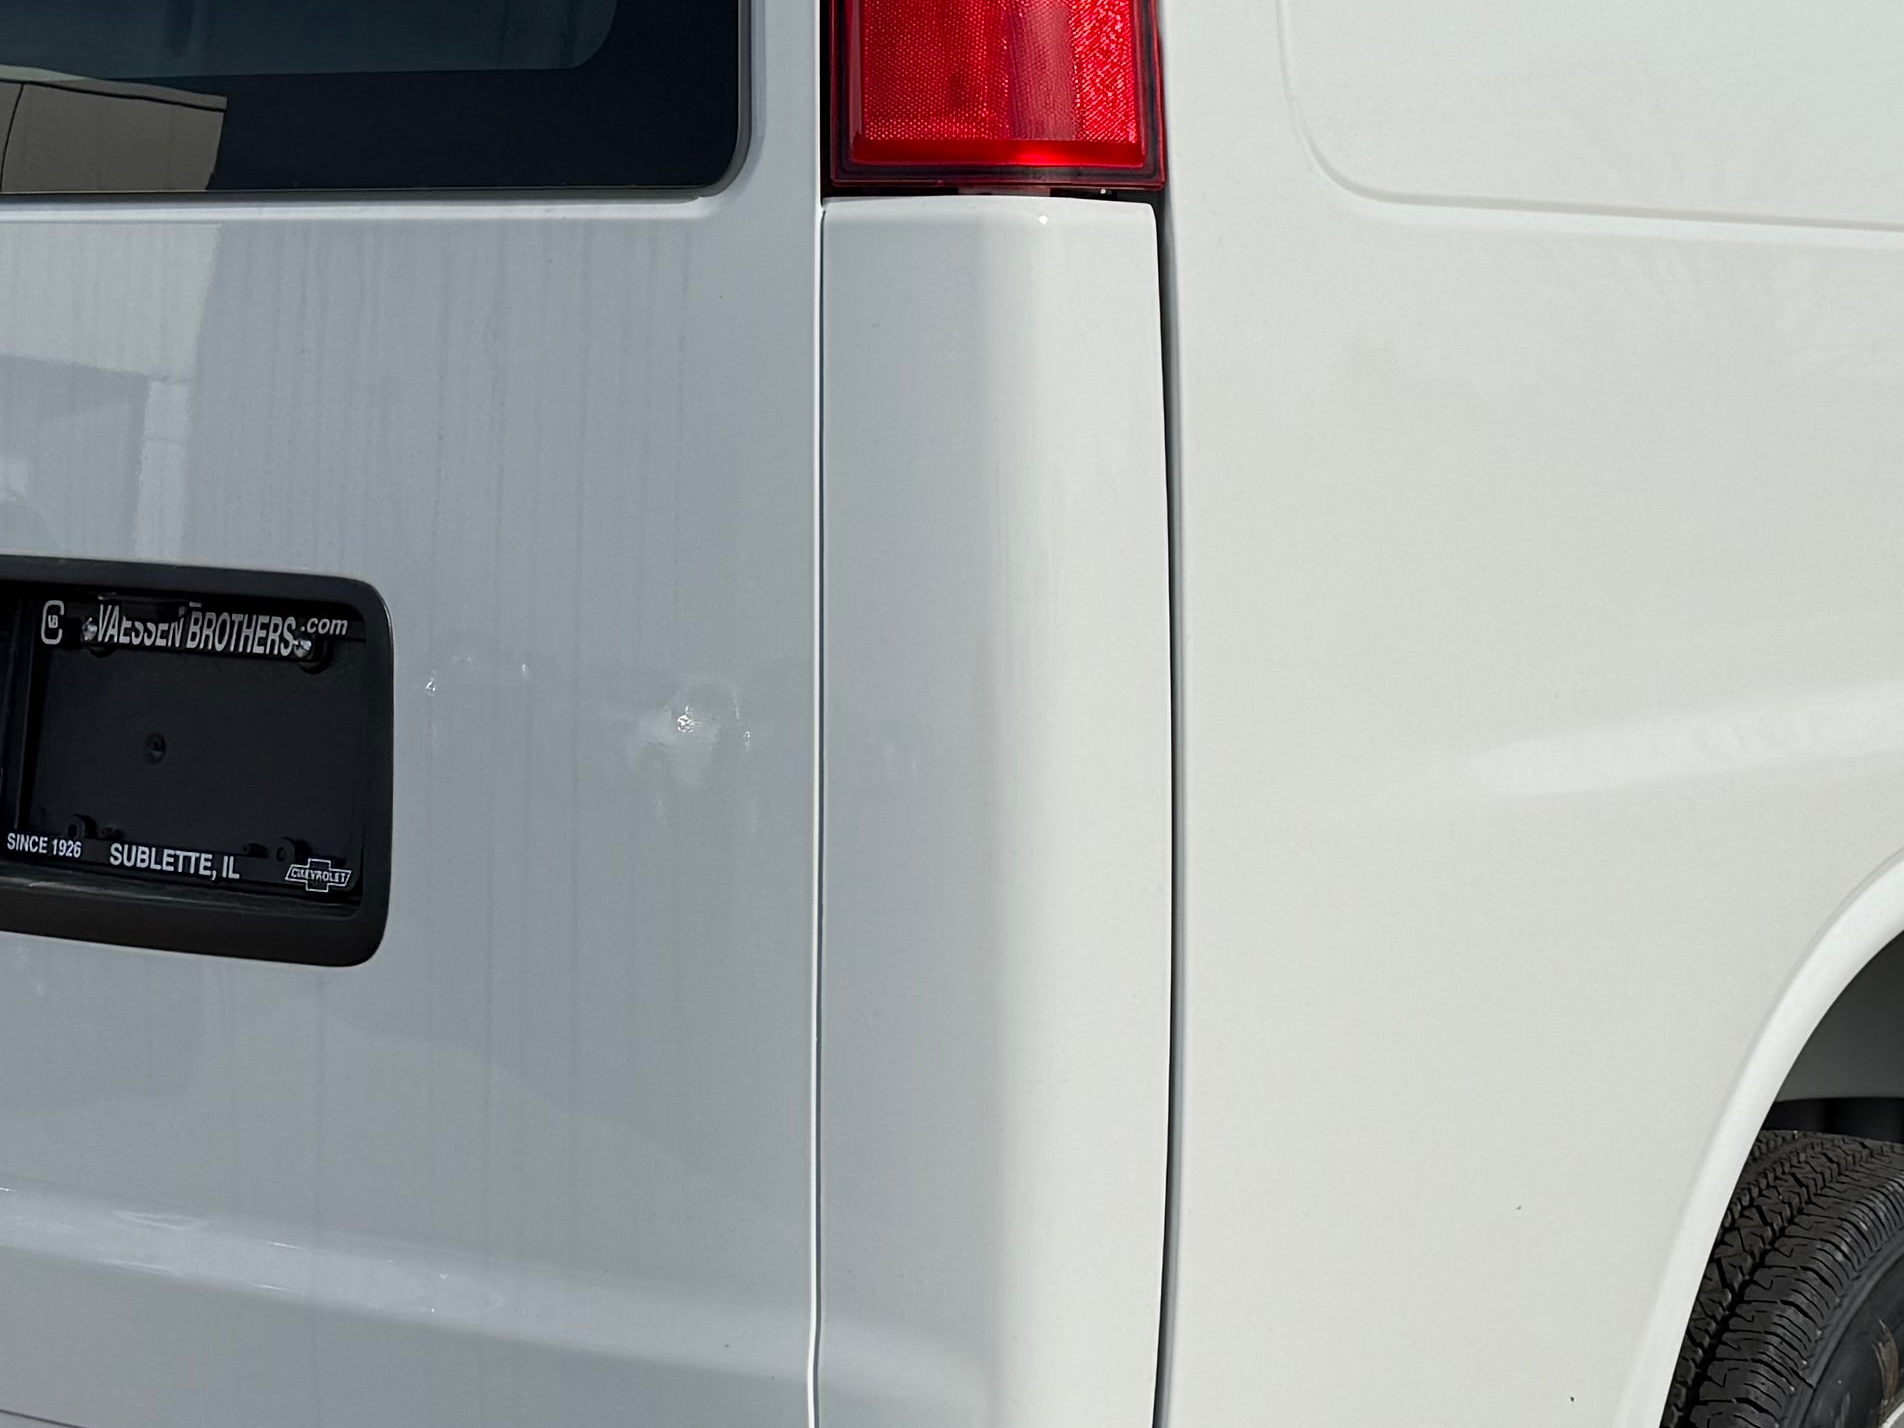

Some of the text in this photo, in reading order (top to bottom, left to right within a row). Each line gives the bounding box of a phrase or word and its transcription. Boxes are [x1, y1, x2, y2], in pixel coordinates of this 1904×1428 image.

[7, 833, 82, 859] SINCE 1926
[109, 843, 240, 881] SUBLETTE, IL
